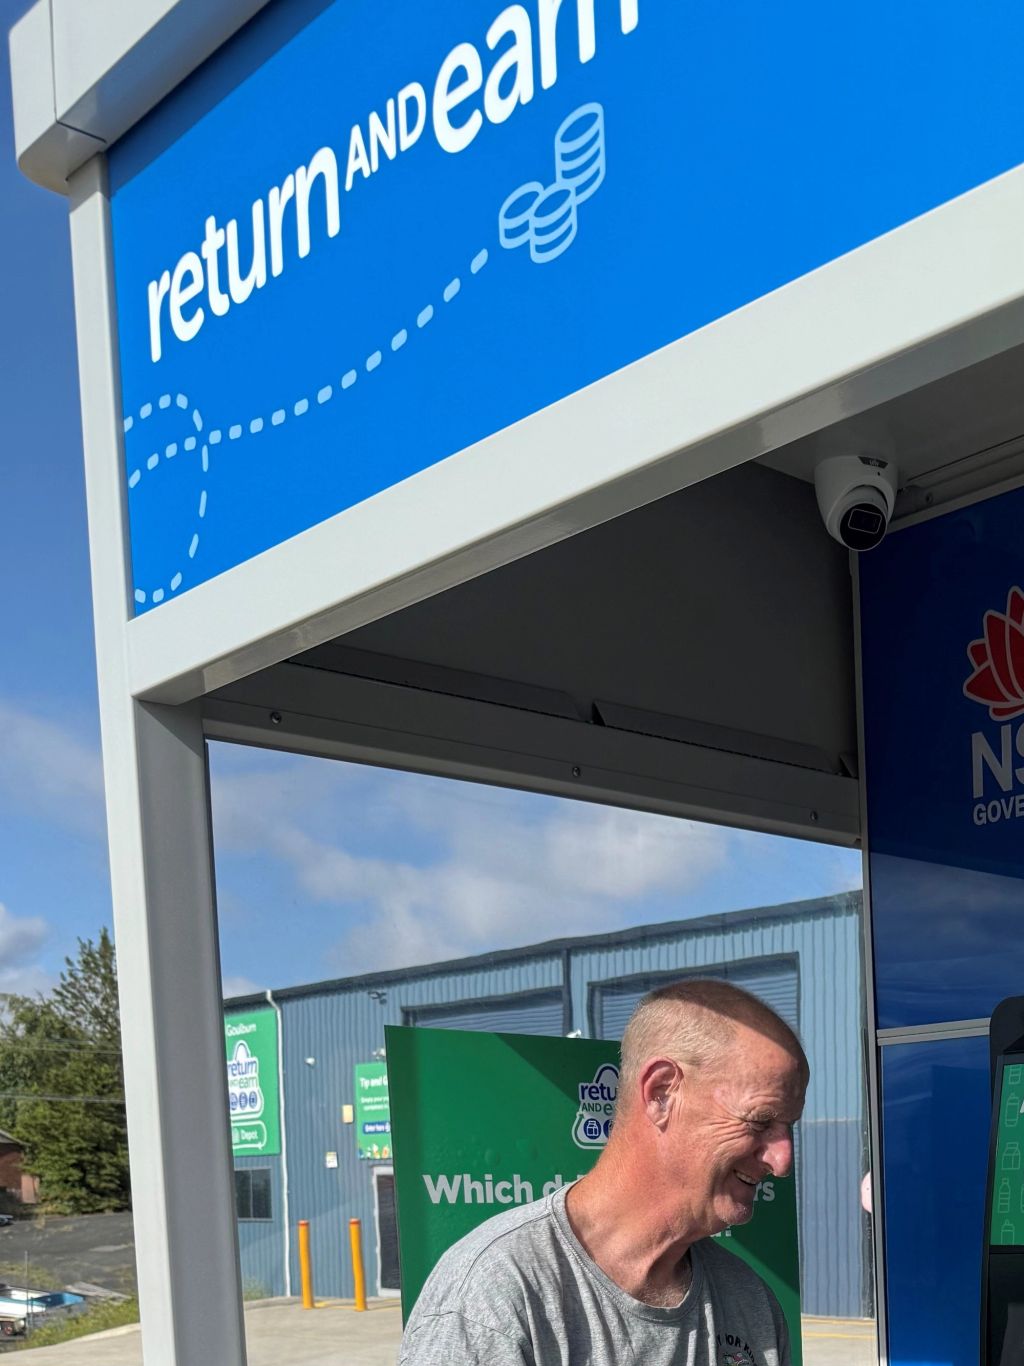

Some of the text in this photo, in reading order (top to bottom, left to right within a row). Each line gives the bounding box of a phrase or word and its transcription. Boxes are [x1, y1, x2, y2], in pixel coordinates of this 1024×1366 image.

[147, 146, 341, 363] return
[345, 82, 426, 191] AND
[228, 1060, 258, 1077] return
[580, 1083, 618, 1102] retu
[581, 1102, 602, 1113] AND
[422, 1174, 533, 1204] Which
